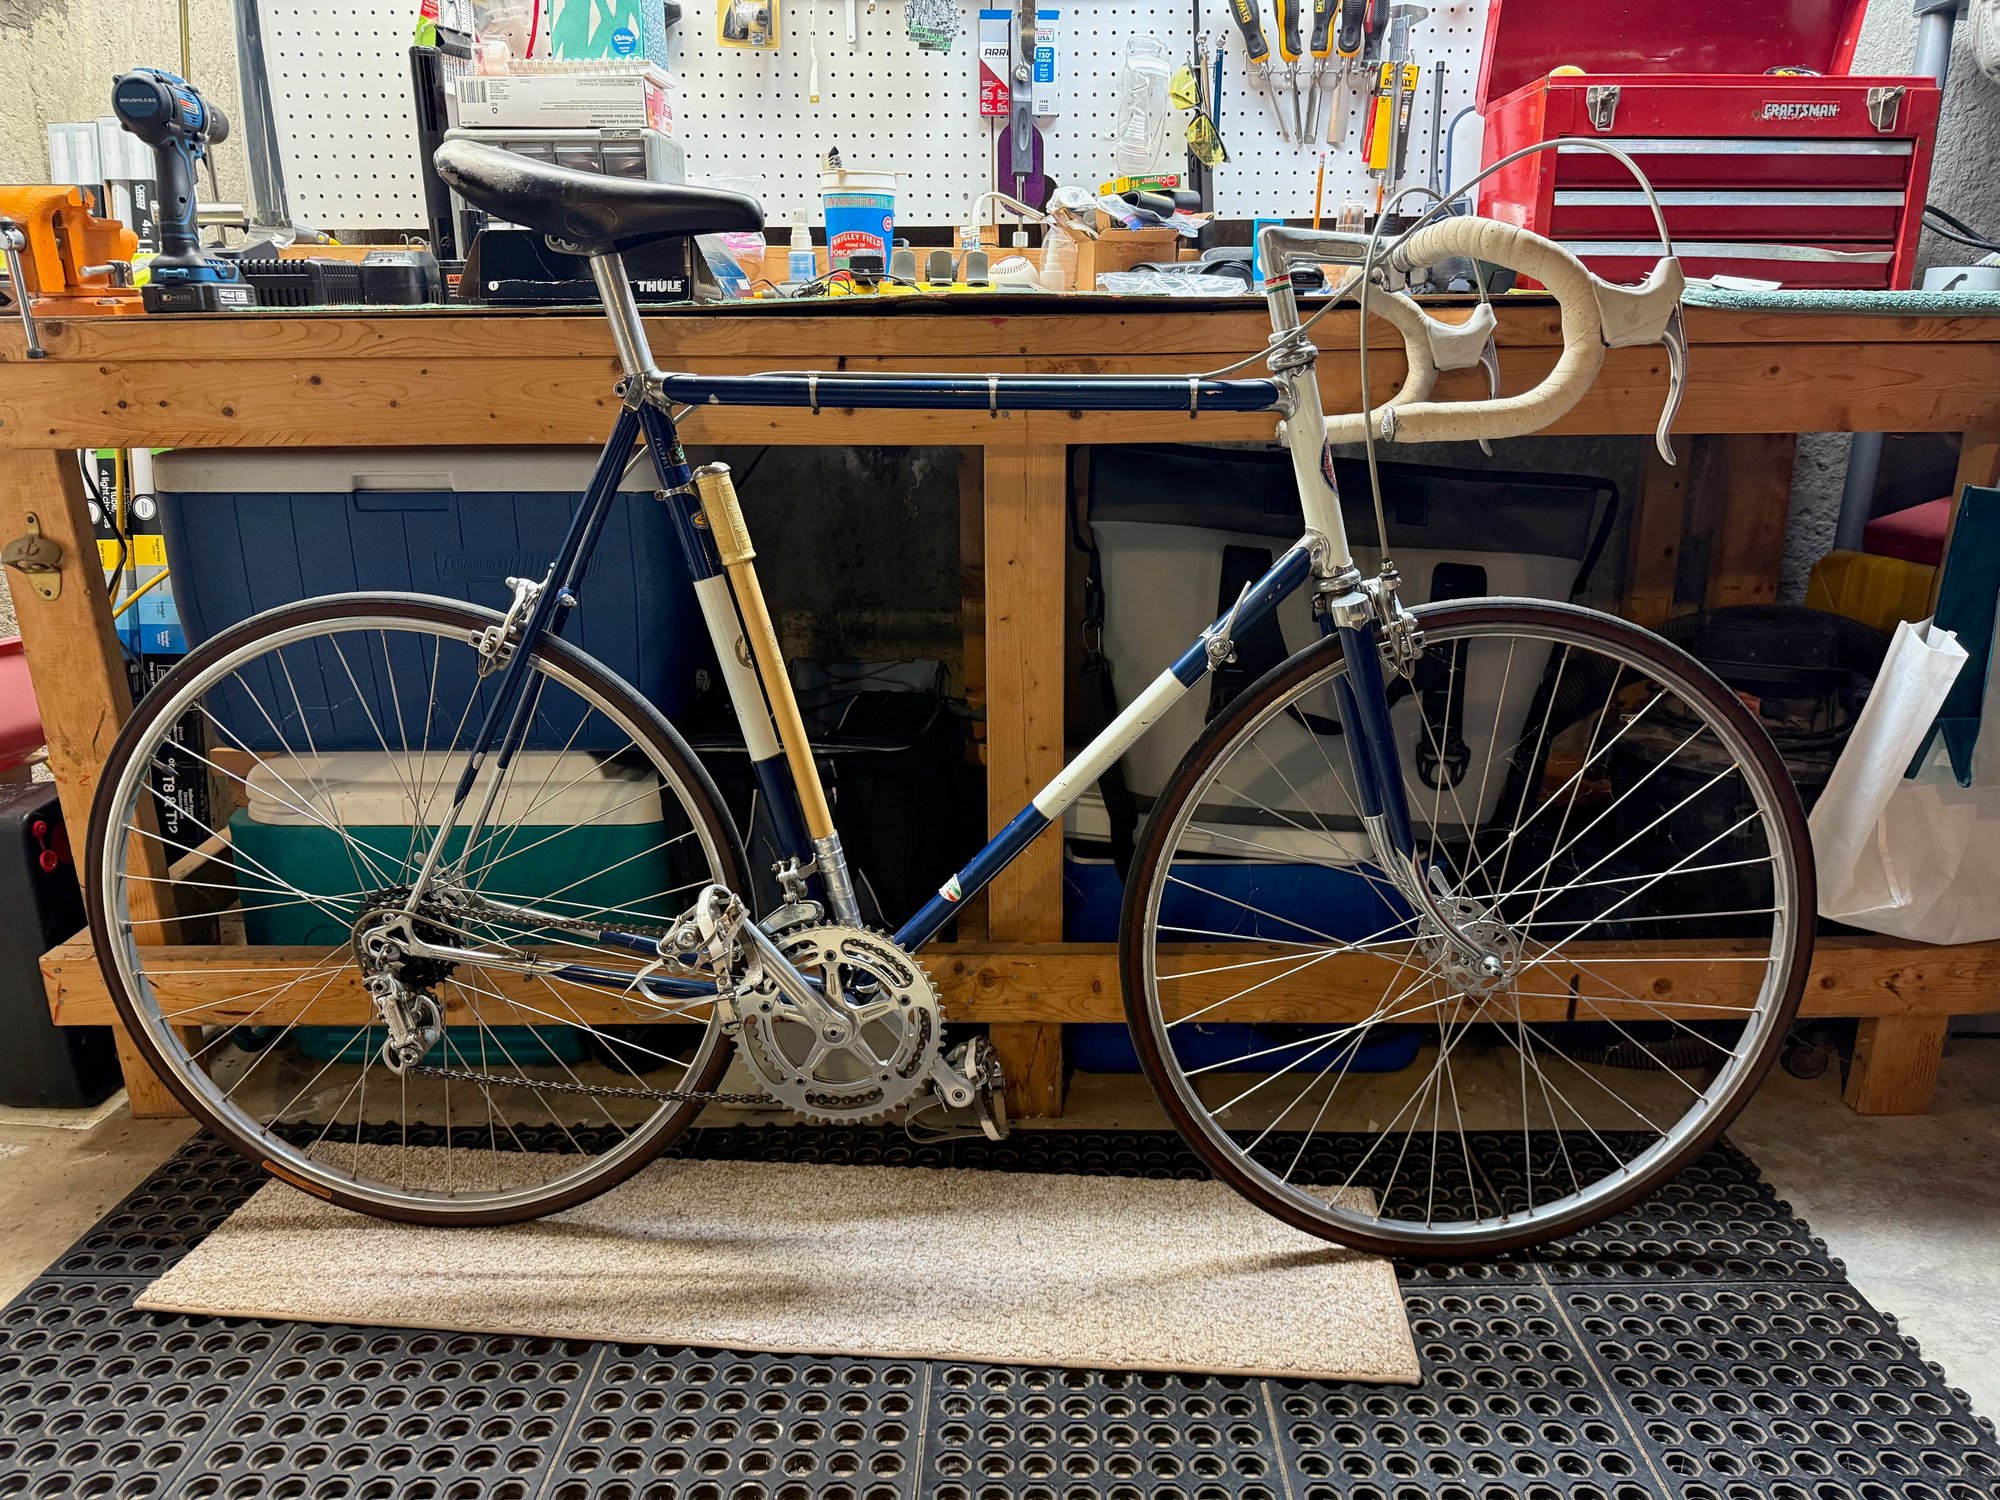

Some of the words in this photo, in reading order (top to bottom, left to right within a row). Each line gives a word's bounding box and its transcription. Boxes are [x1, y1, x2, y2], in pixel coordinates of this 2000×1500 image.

[984, 48, 1009, 56] ARR
[1763, 103, 1838, 117] CRAFTSMAN
[611, 130, 630, 138] ACE
[1131, 180, 1140, 188] 16
[1143, 176, 1167, 184] Crayons
[833, 233, 860, 246] WRIGLEY
[862, 234, 881, 247] FIELD
[637, 280, 682, 292] THULE
[100, 476, 110, 495] light
[450, 557, 495, 570] Coleman
[168, 758, 175, 768] or
[162, 776, 175, 792] T8
